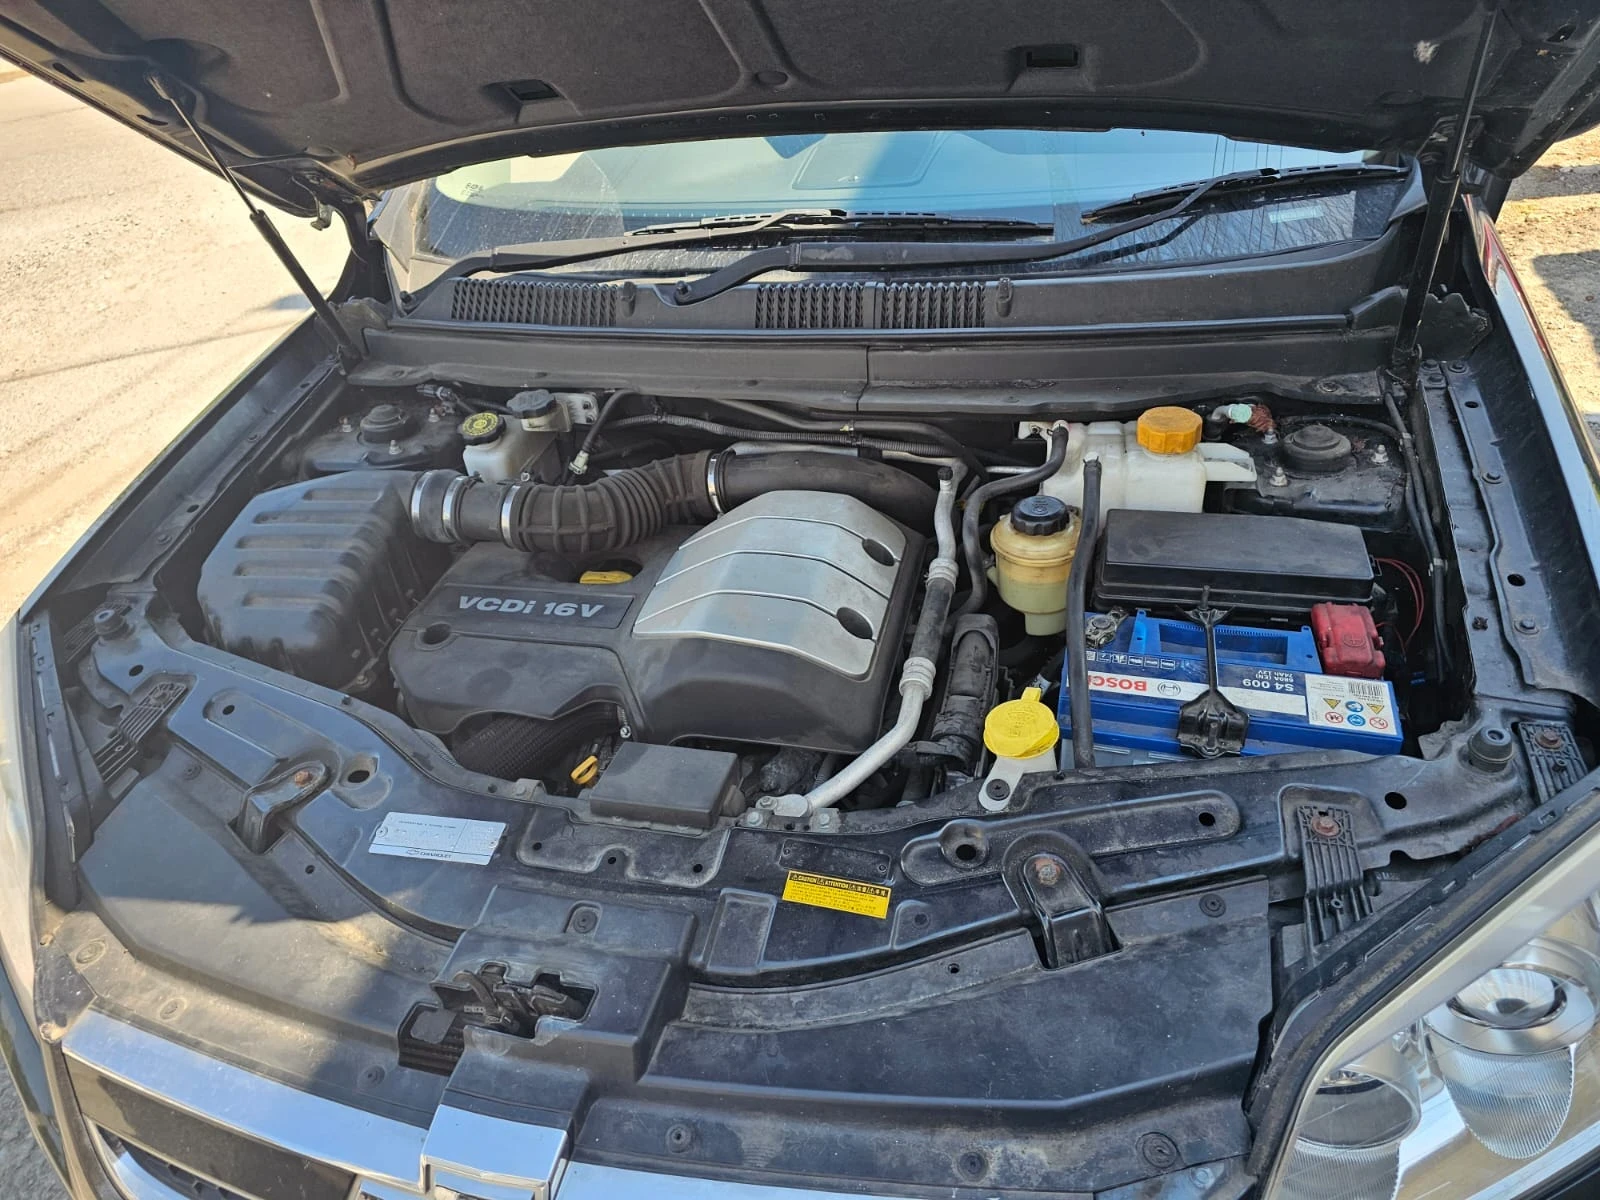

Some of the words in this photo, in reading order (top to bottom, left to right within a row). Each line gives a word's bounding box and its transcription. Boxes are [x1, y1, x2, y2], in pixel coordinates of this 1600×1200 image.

[459, 596, 536, 614] VCDi
[544, 602, 605, 618] 16V
[1242, 678, 1270, 689] 009
[1274, 682, 1294, 692] S4
